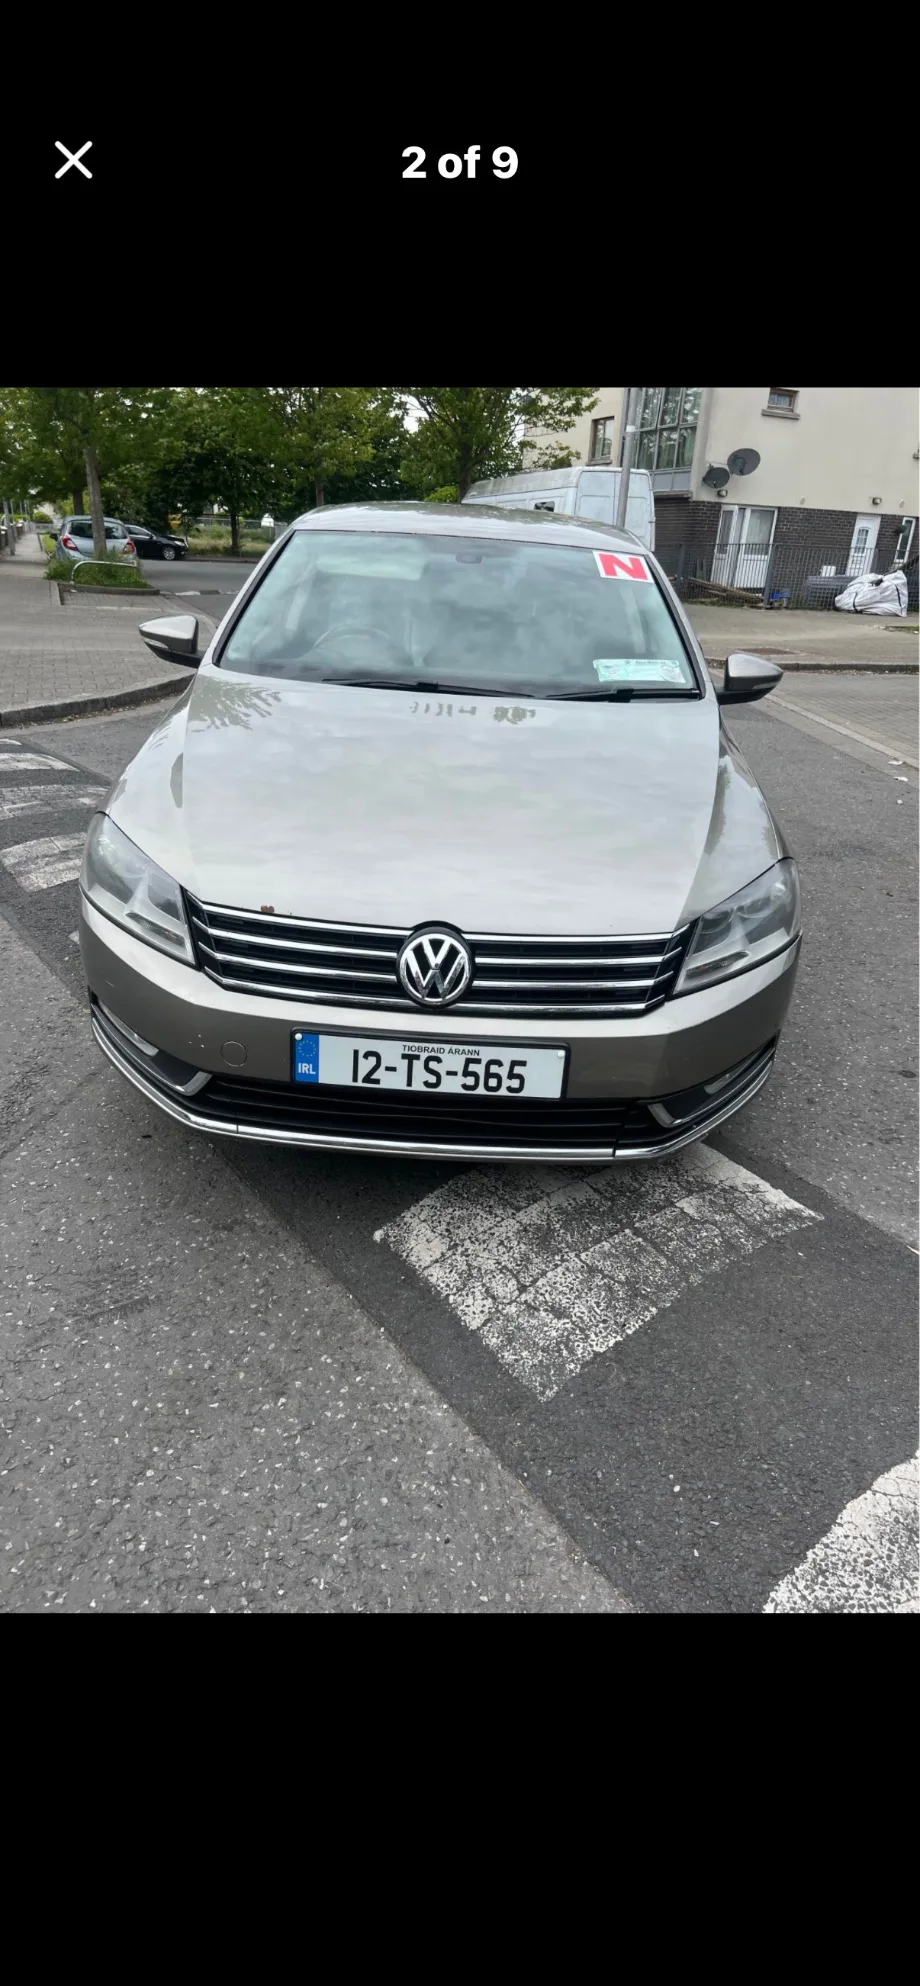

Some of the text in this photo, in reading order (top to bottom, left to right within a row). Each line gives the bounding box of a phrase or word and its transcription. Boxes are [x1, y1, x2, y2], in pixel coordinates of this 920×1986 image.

[598, 553, 648, 580] N
[401, 933, 468, 1001] VW
[402, 1044, 480, 1056] TIOBRAID ÁRANN
[298, 1062, 317, 1075] IRL
[352, 1048, 528, 1094] 12-TS-565
